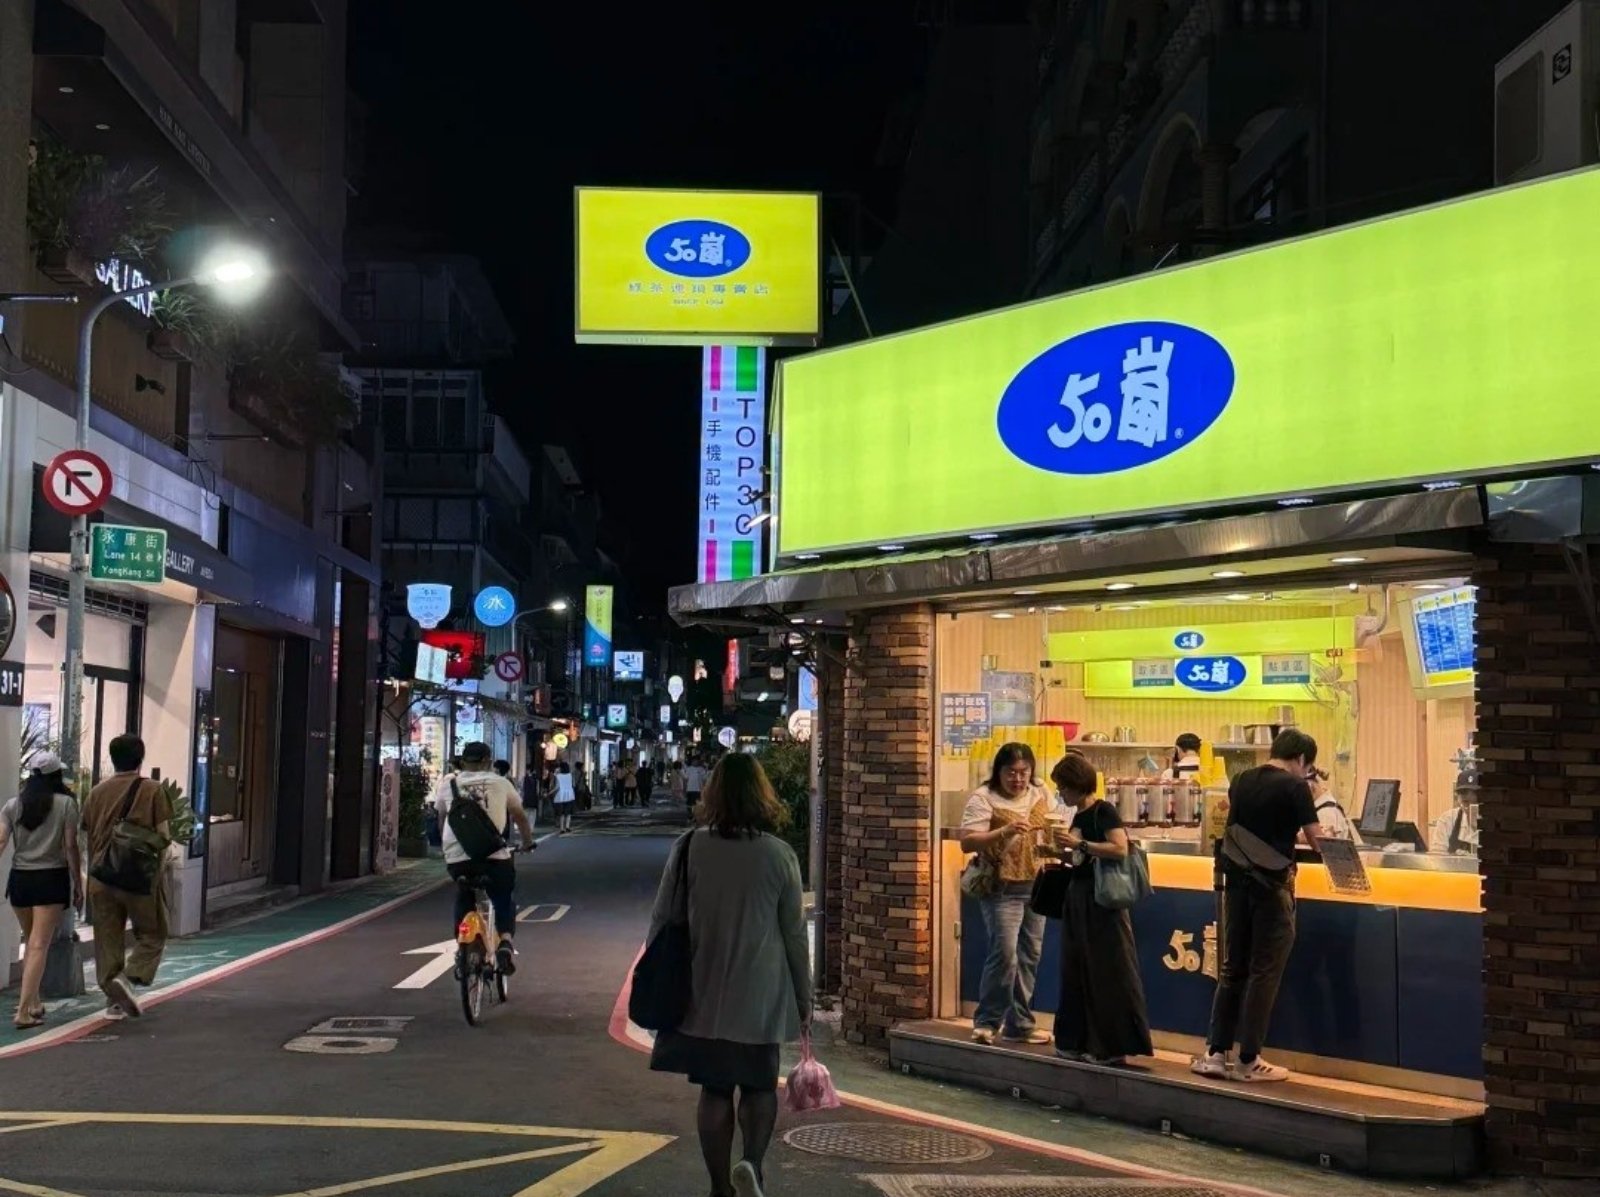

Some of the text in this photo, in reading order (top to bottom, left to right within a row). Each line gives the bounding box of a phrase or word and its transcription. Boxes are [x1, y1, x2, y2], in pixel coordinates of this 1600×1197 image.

[663, 231, 726, 266] 50嵐
[1046, 335, 1175, 449] 50嵐
[704, 418, 722, 511] 手機配件
[734, 397, 757, 535] TOP3C
[102, 530, 158, 548] 永康街
[104, 550, 125, 560] Lane
[130, 552, 140, 561] 14
[166, 549, 195, 574] GALLERY
[1, 669, 22, 696] 31-1
[1187, 660, 1230, 685] 50嵐
